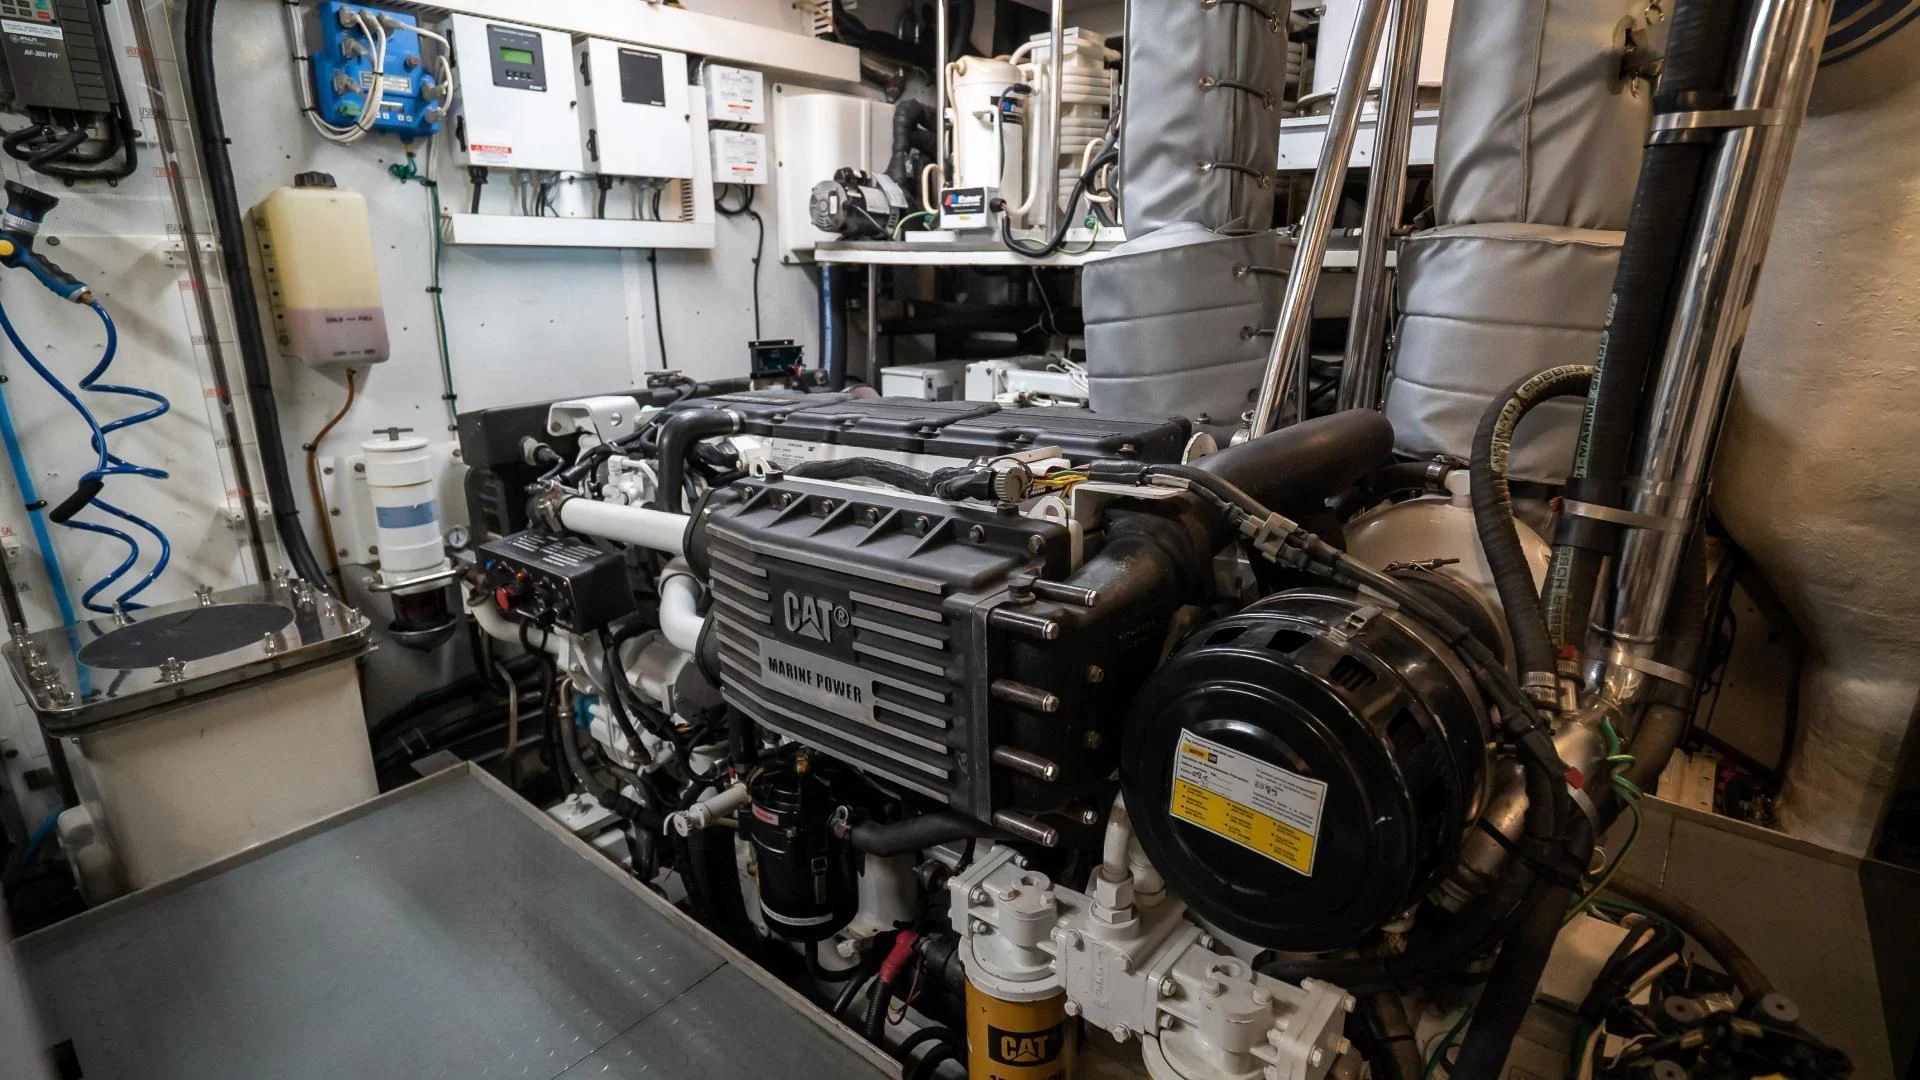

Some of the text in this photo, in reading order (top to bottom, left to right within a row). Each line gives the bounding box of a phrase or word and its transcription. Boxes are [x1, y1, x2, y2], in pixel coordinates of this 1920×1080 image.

[768, 656, 862, 704] MARINE POWER
[1001, 1035, 1048, 1062] CAT
